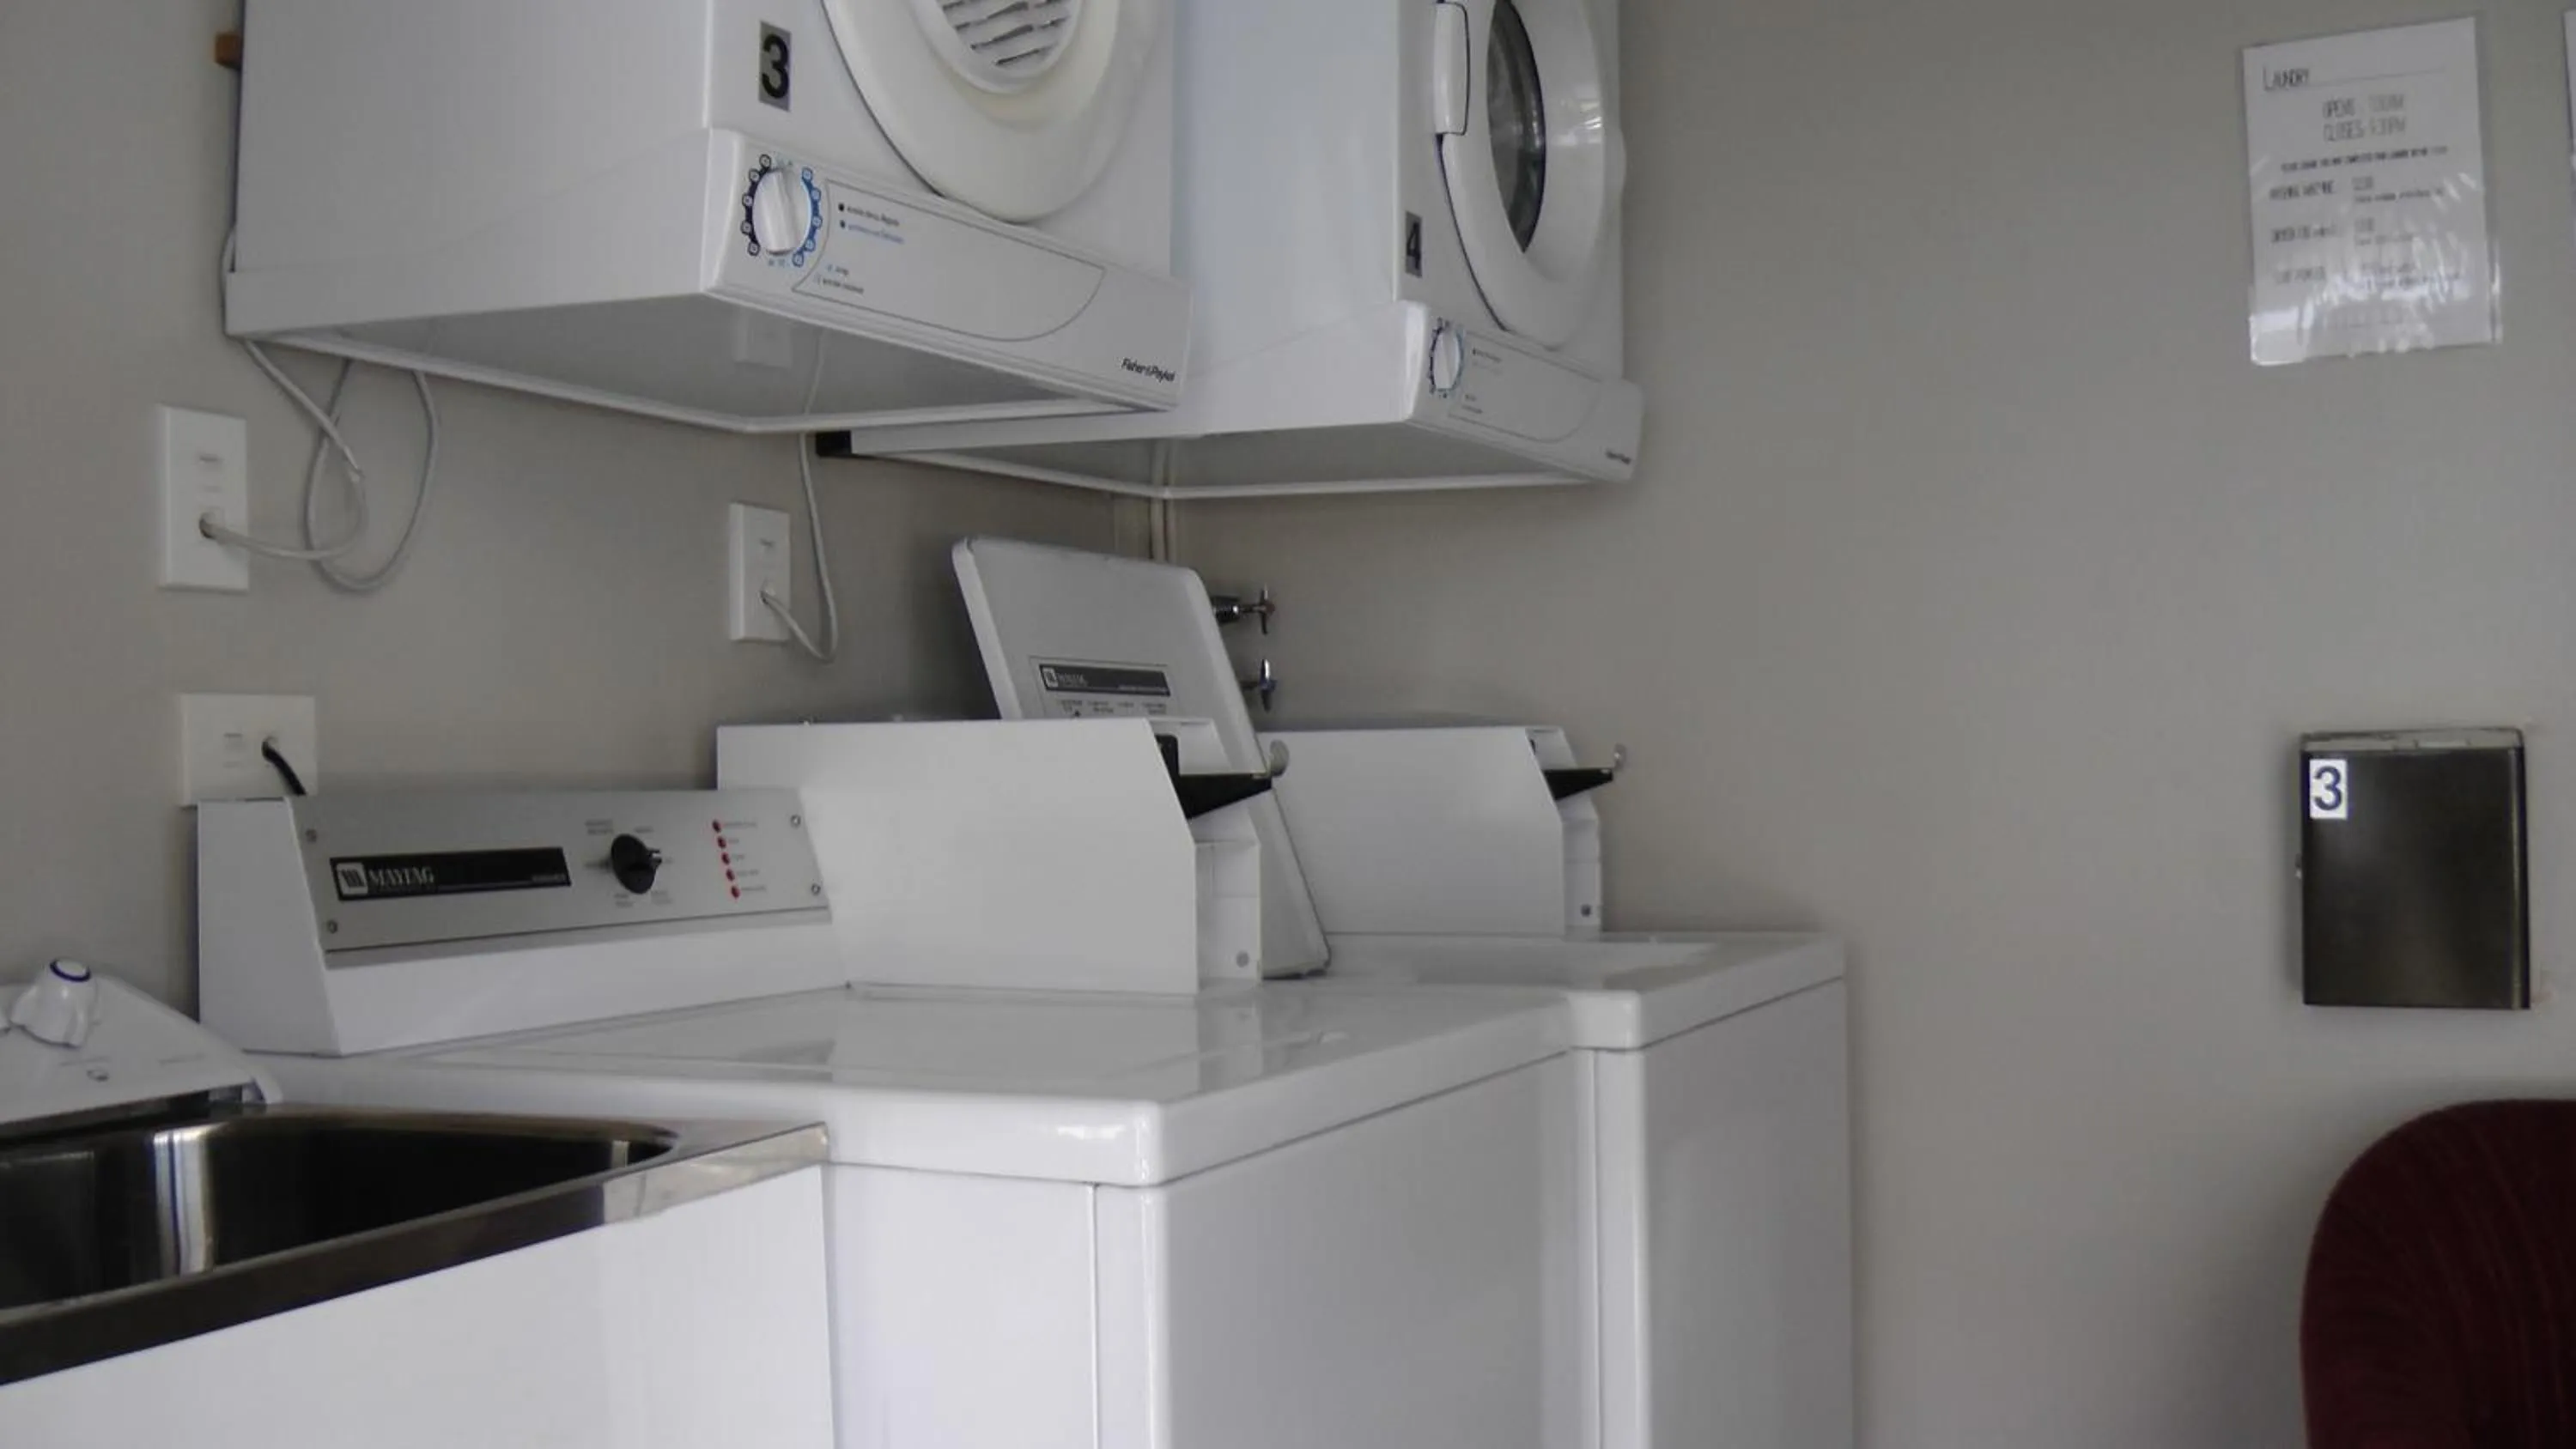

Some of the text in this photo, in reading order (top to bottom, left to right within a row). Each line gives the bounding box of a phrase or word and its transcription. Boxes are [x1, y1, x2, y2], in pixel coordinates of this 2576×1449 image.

[762, 34, 789, 99] 3
[1406, 221, 1421, 270] 4
[2314, 765, 2342, 811] 3
[368, 866, 435, 888] MAYTAG
